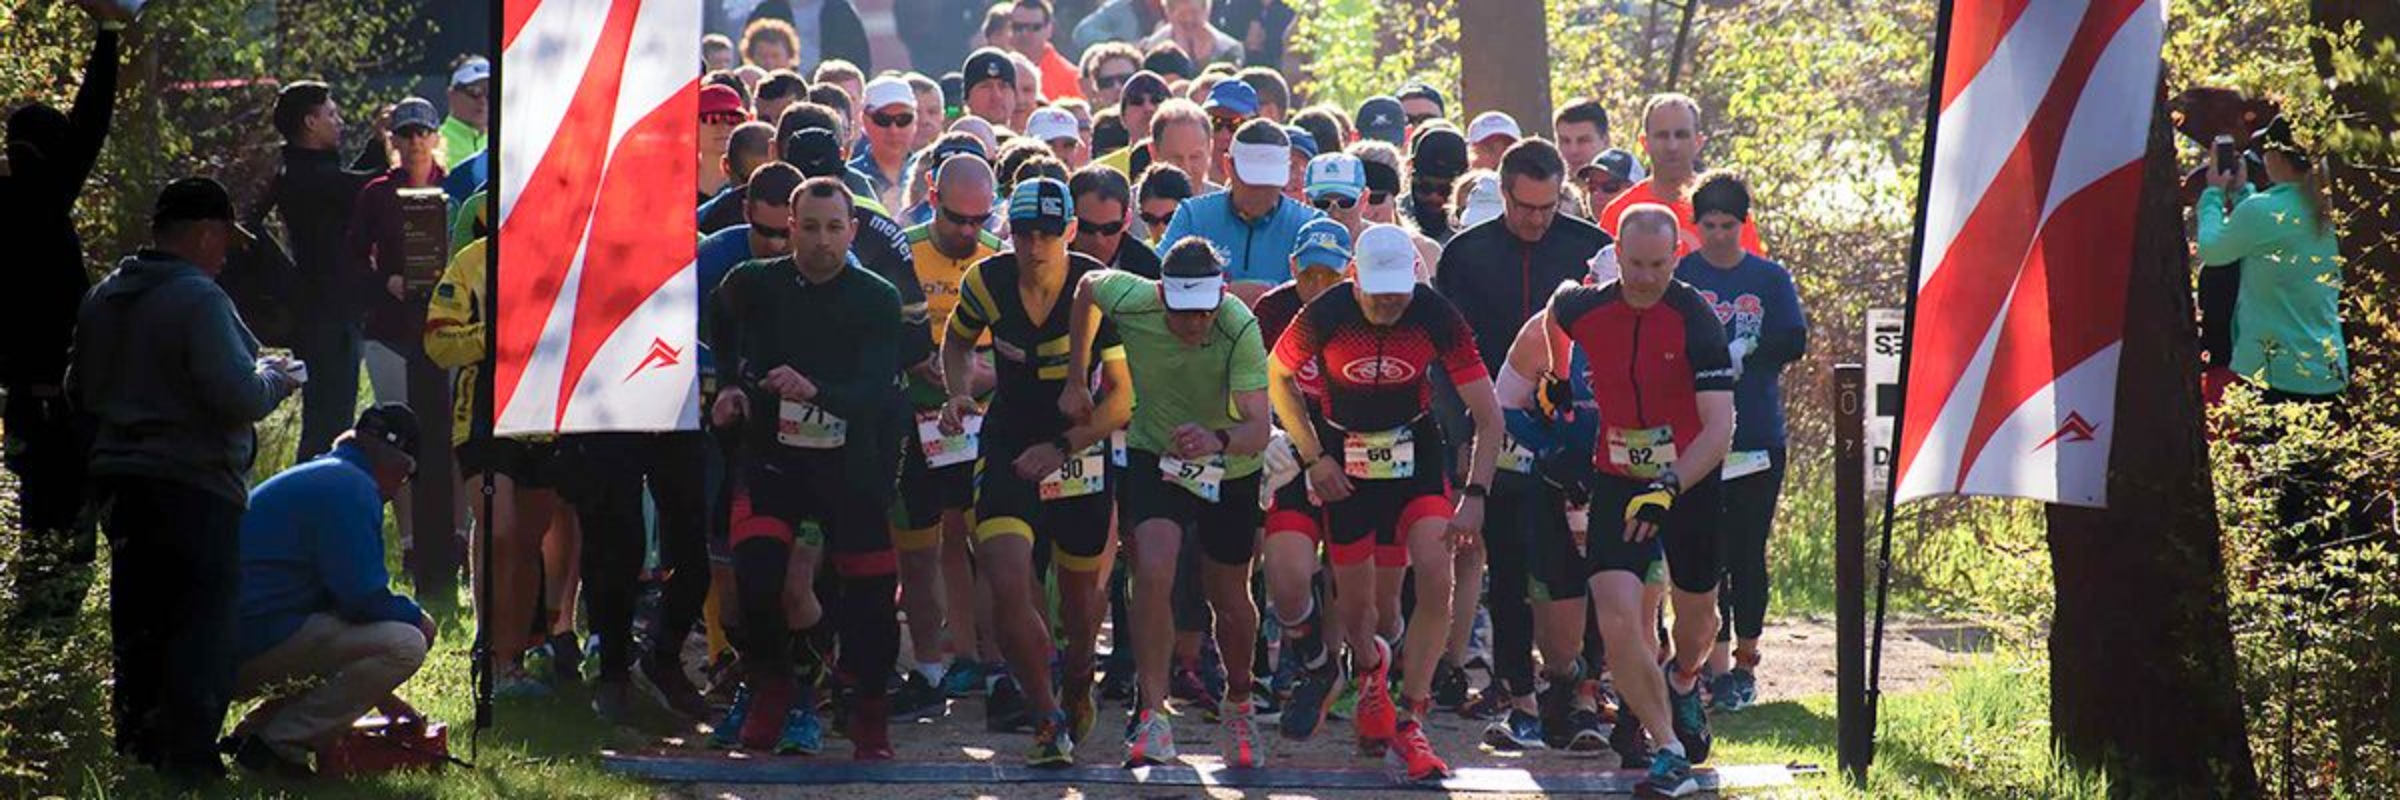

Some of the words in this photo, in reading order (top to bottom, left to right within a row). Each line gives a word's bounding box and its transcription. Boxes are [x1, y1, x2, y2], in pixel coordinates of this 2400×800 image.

[869, 214, 913, 262] meijer
[802, 404, 824, 425] 71
[1628, 447, 1655, 466] 62
[1061, 457, 1083, 480] 90
[1178, 462, 1205, 480] 57
